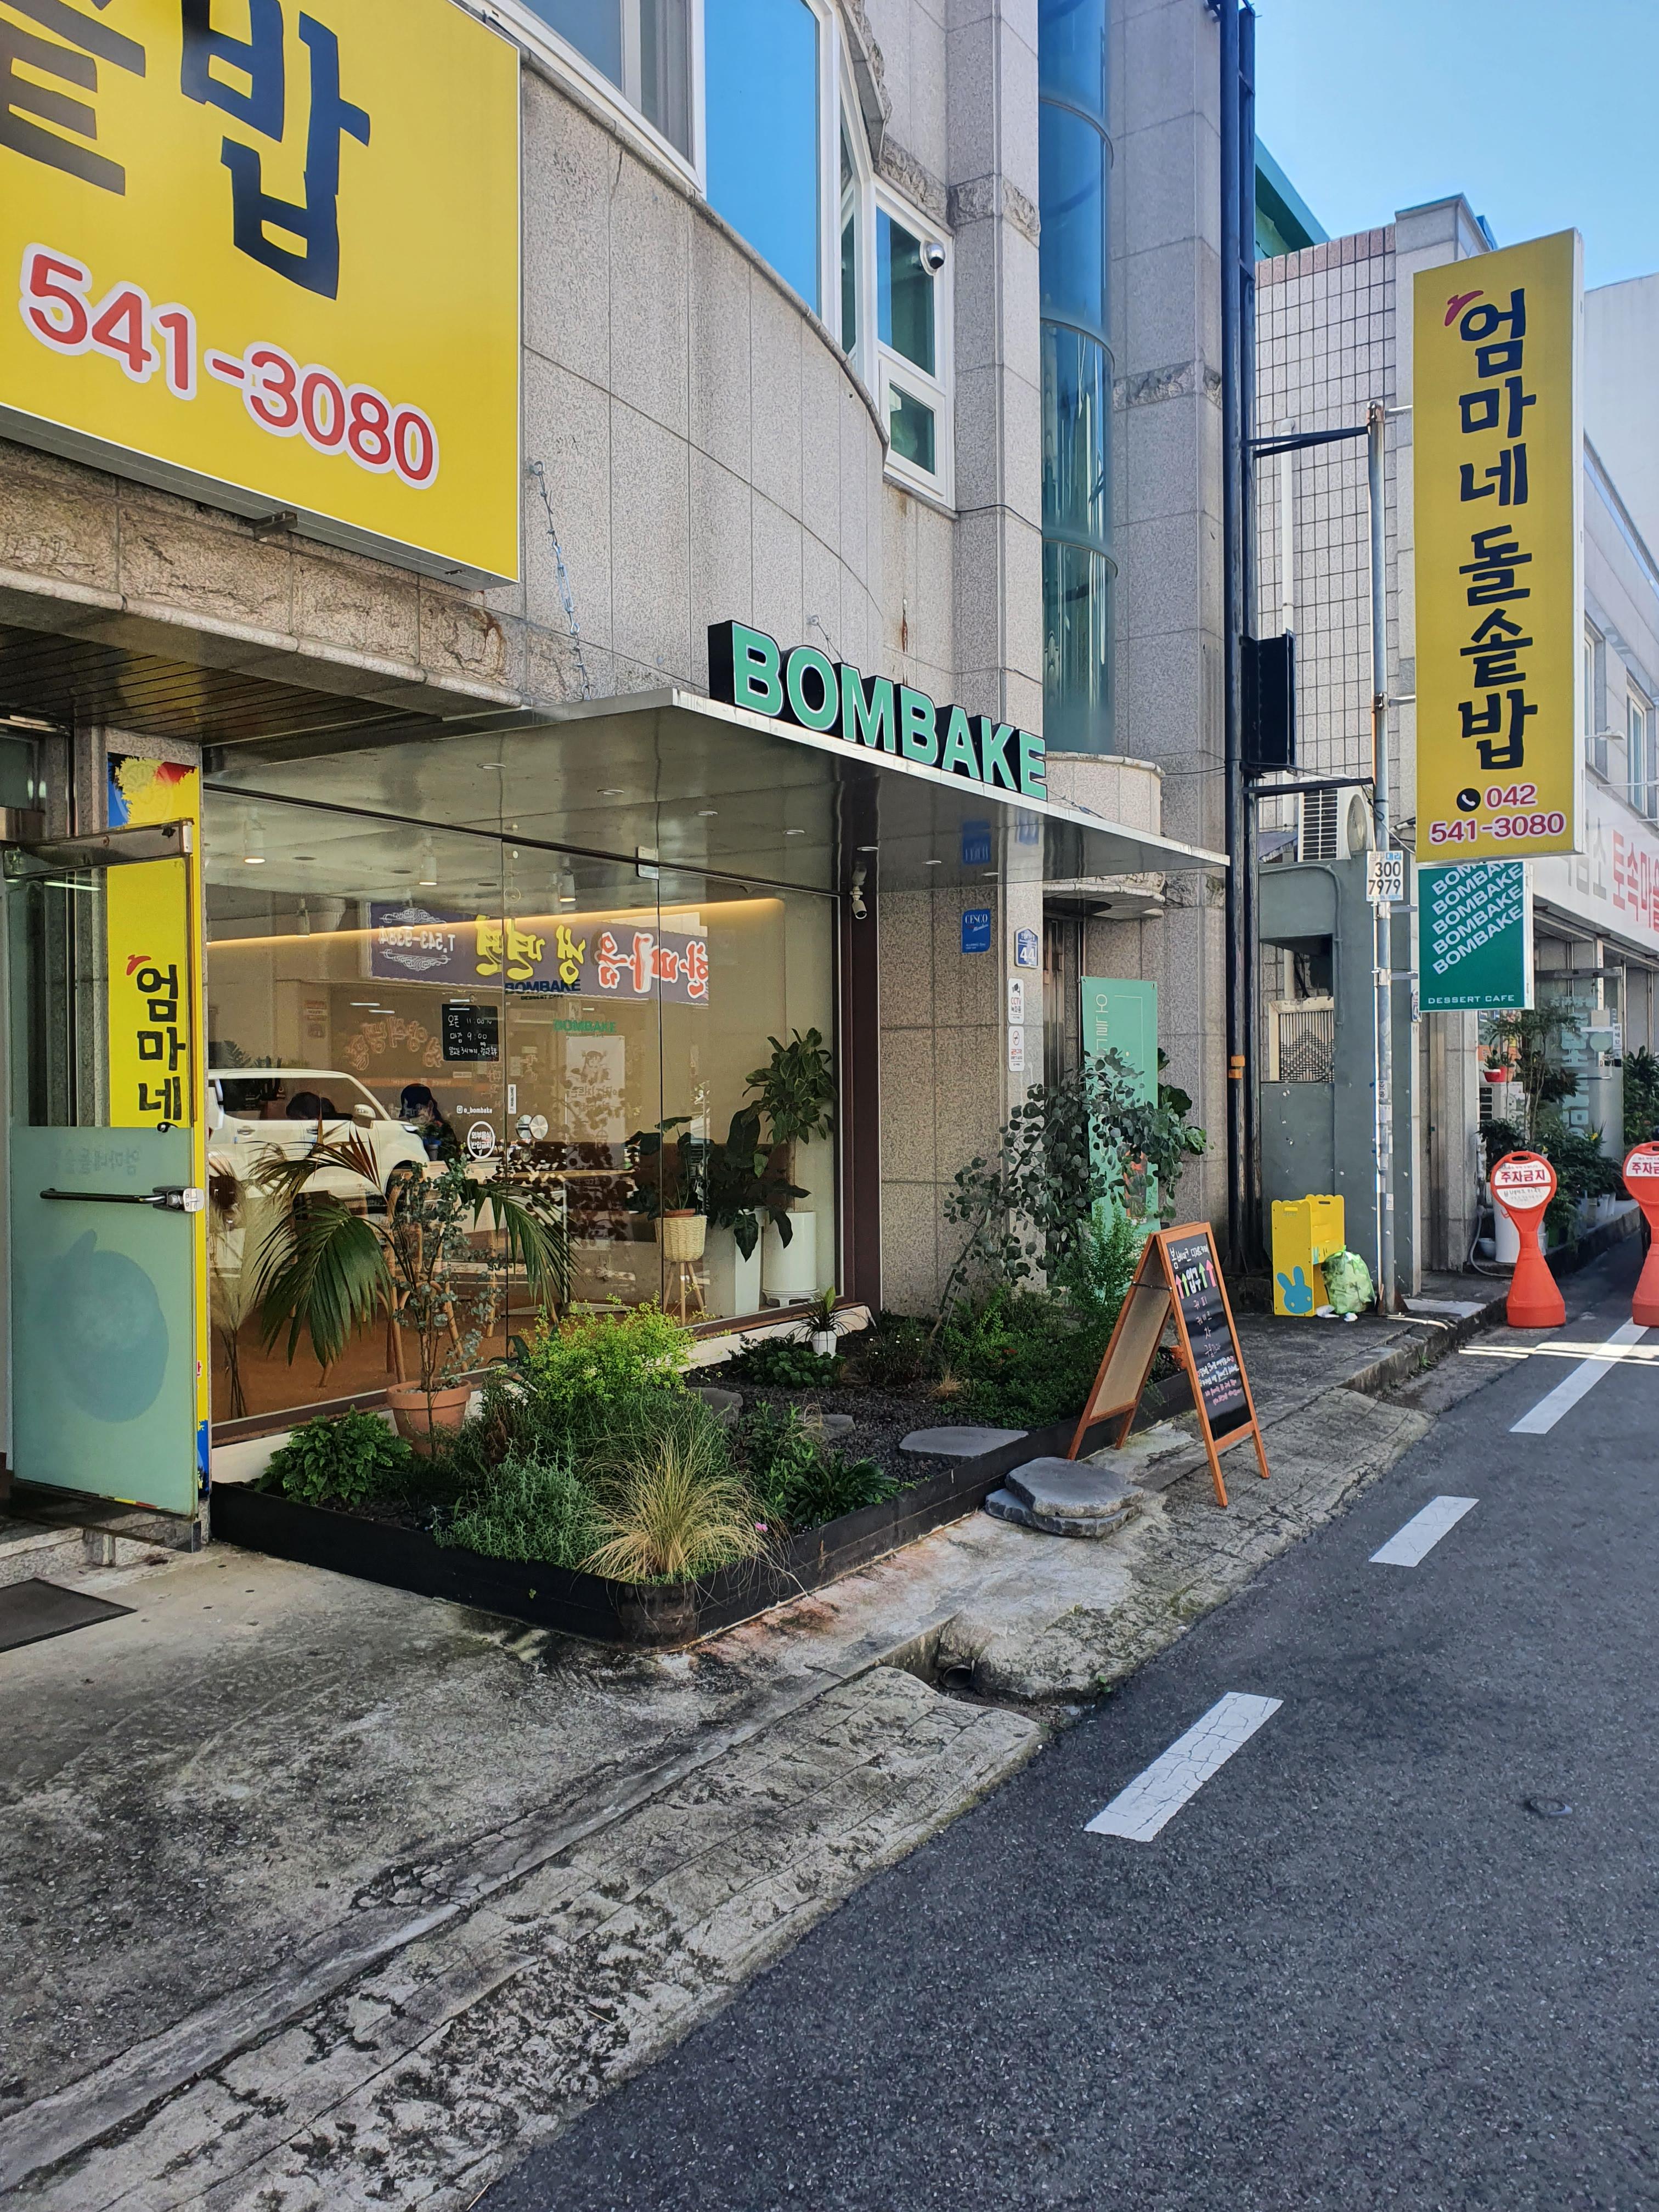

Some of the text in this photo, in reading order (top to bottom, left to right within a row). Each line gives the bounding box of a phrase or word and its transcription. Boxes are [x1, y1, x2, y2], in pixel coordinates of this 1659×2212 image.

[21, 245, 437, 487] 541-3080
[727, 620, 1048, 802] BOMBAKE
[1485, 785, 1538, 809] 042
[1430, 812, 1565, 844] 541-3080
[1375, 861, 1401, 877] 300
[1368, 879, 1401, 895] 7979
[1432, 864, 1523, 935] BOMBAKE
[965, 914, 988, 924] CESCO
[1432, 884, 1523, 955] BOMBAKE
[1432, 905, 1523, 975] BOMBAKE
[1019, 946, 1036, 962] 44
[1011, 997, 1022, 1005] CCTV
[1428, 996, 1481, 1004] DESSERT
